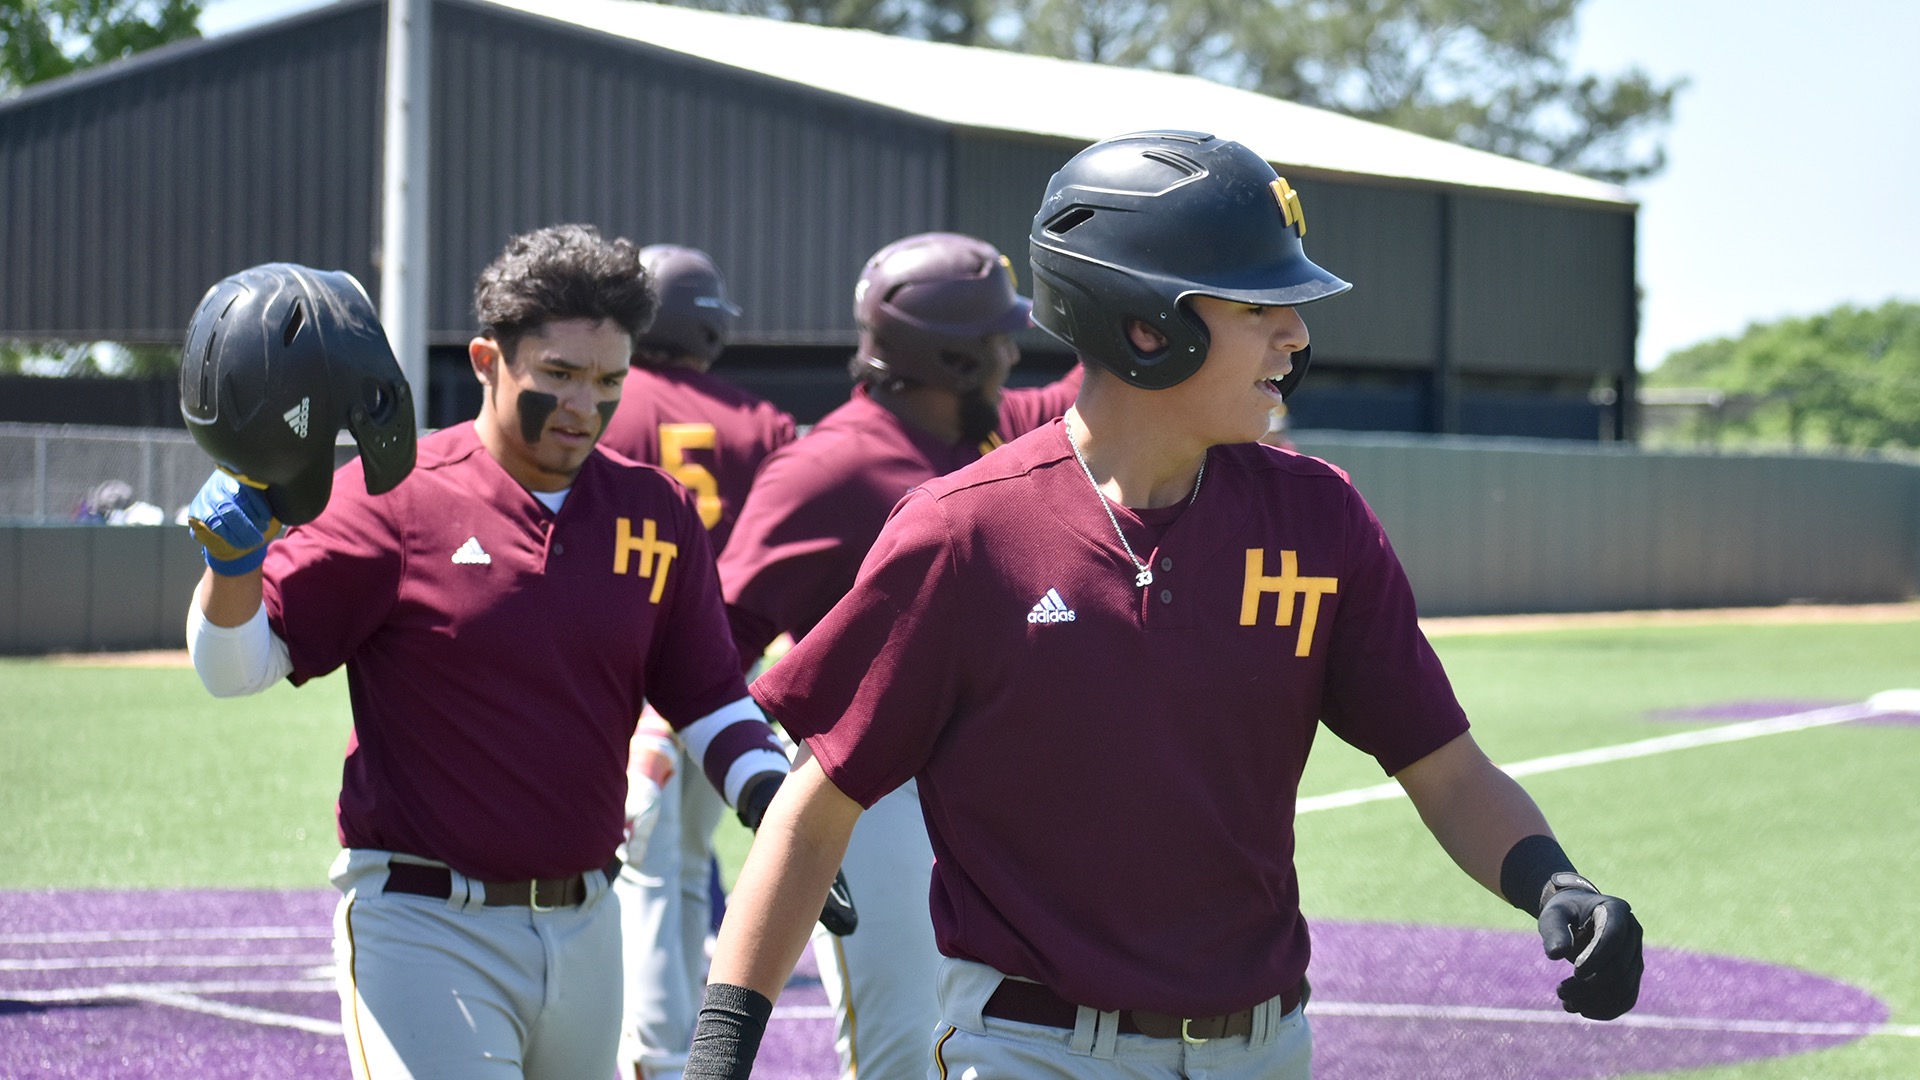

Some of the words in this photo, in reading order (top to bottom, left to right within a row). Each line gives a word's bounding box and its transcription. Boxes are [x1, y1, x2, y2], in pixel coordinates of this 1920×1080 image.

[300, 397, 310, 438] adidas
[659, 423, 722, 531] 5
[613, 517, 678, 604] HT
[1135, 571, 1153, 588] 33
[1027, 609, 1076, 624] adidas
[1239, 548, 1339, 657] HT
